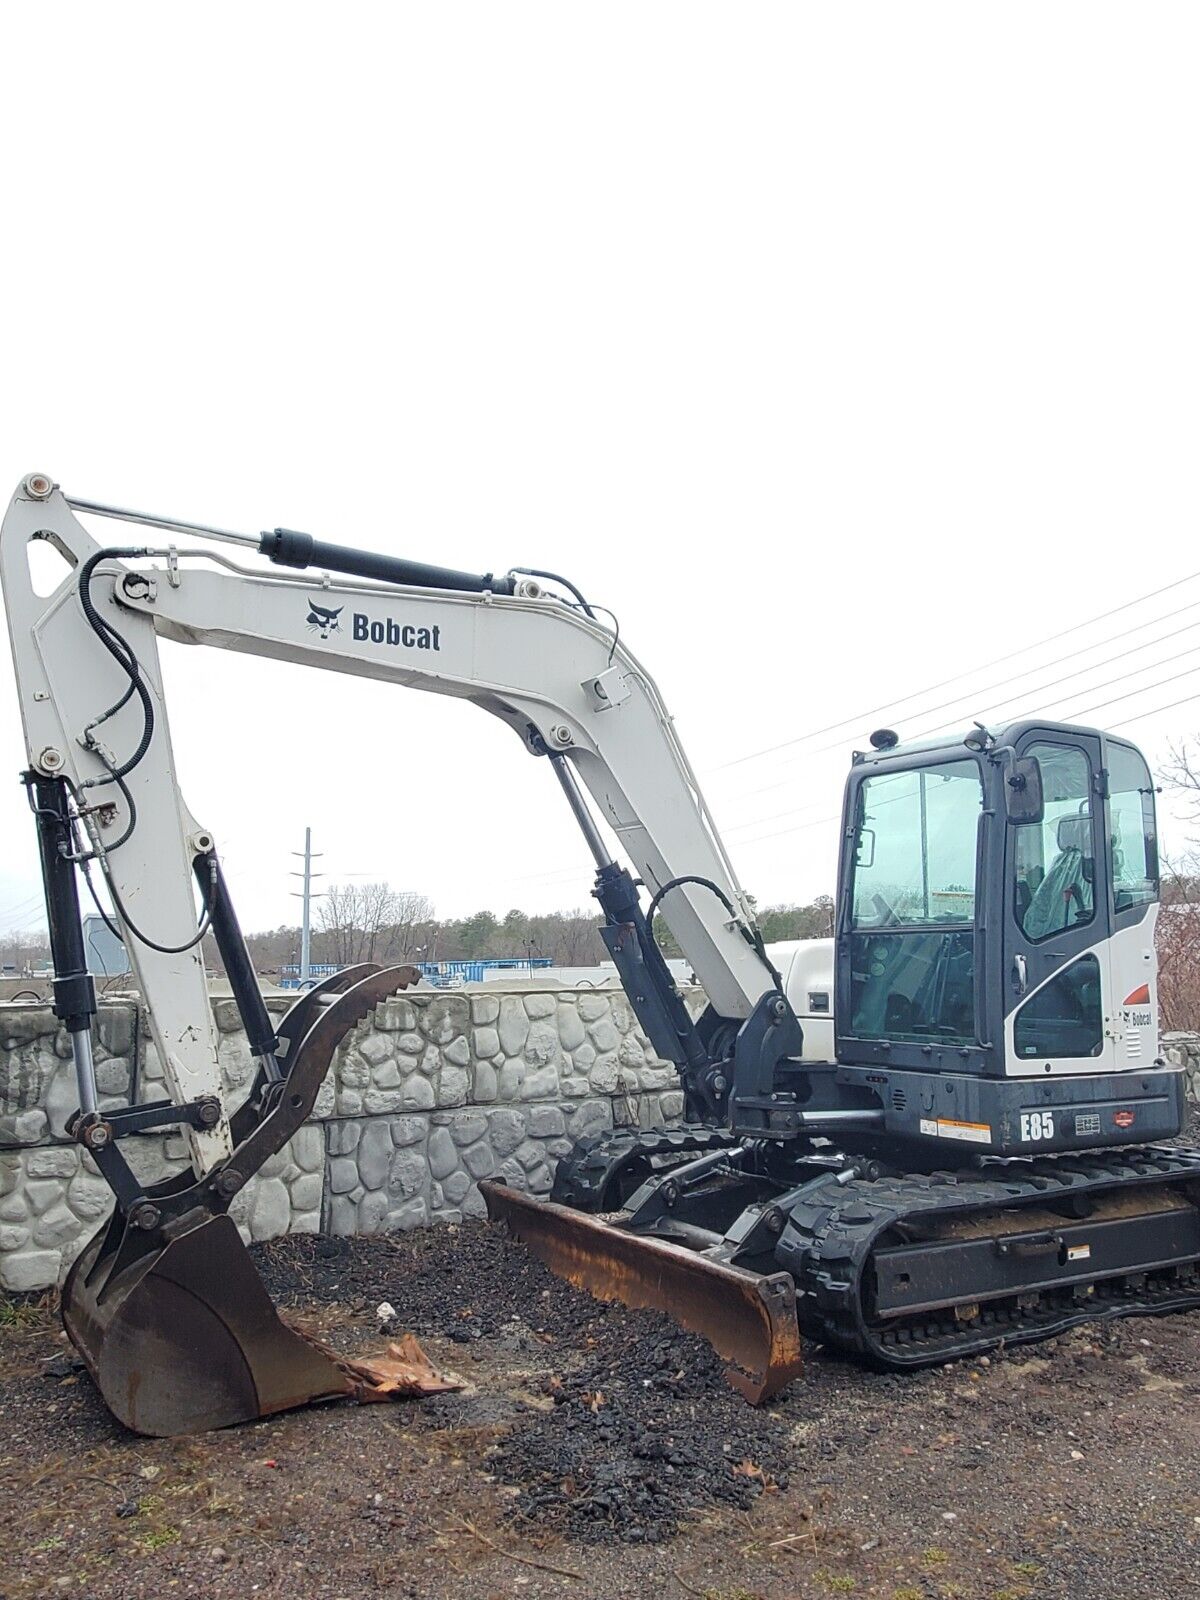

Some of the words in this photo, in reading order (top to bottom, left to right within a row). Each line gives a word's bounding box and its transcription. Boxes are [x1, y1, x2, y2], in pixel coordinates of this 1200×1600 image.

[353, 613, 440, 651] Bobcat
[1132, 1012, 1152, 1027] Bobcat
[1020, 1112, 1055, 1142] E85
